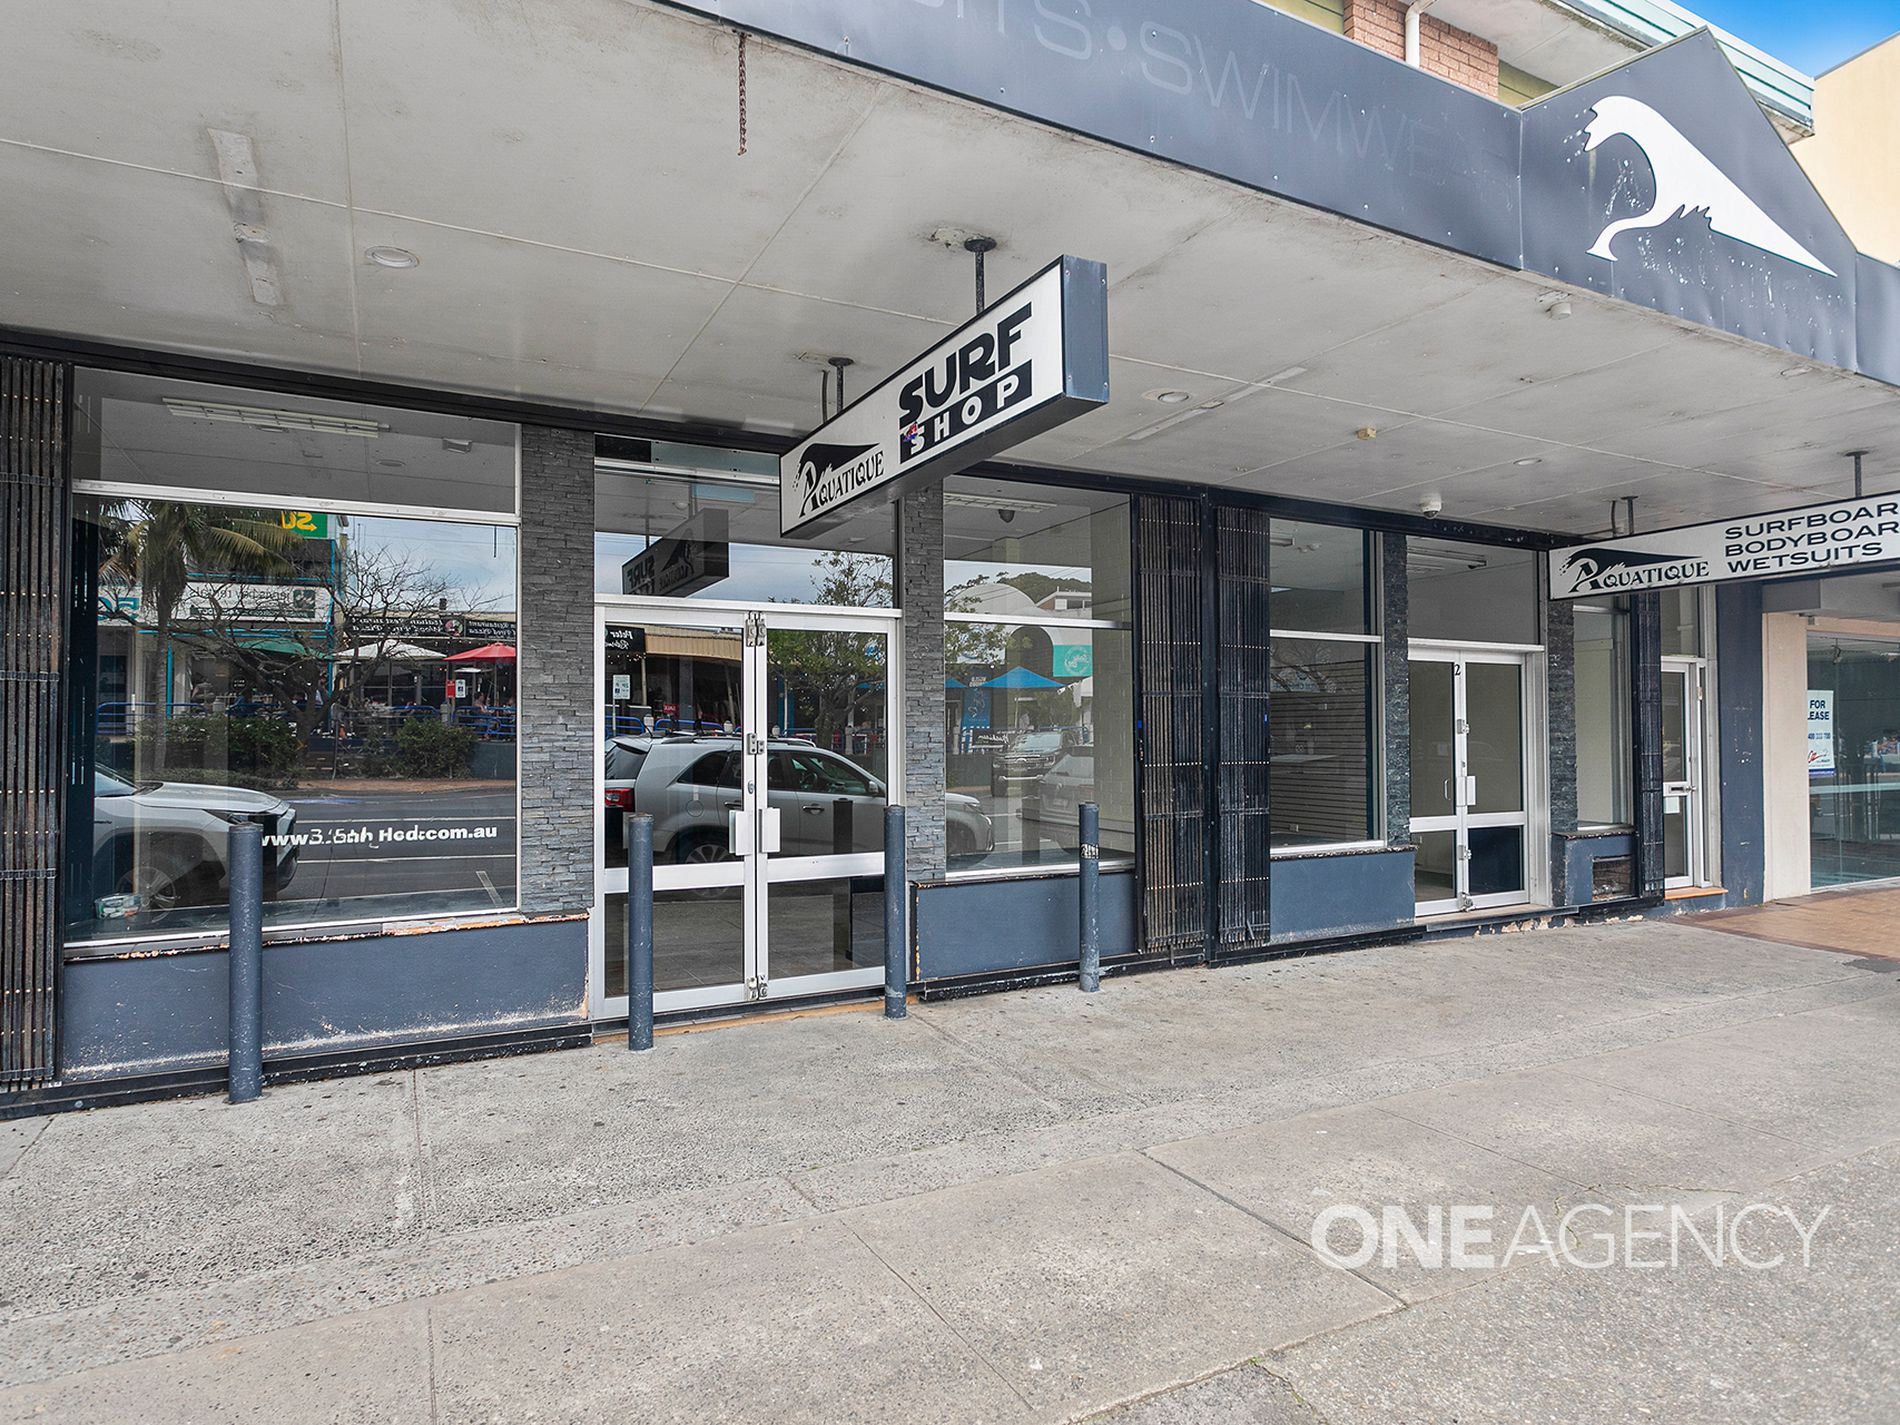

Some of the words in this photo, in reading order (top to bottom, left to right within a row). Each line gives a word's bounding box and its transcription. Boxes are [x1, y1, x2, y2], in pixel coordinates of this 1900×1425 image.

[899, 301, 1032, 430] SURF
[908, 374, 1019, 455] SHOP
[1724, 521, 1899, 557] BODYBOAR
[1725, 502, 1899, 540] SURFBOAR
[1727, 542, 1883, 573] WETSUITS
[1454, 664, 1461, 675] 2
[1809, 700, 1826, 709] FOR
